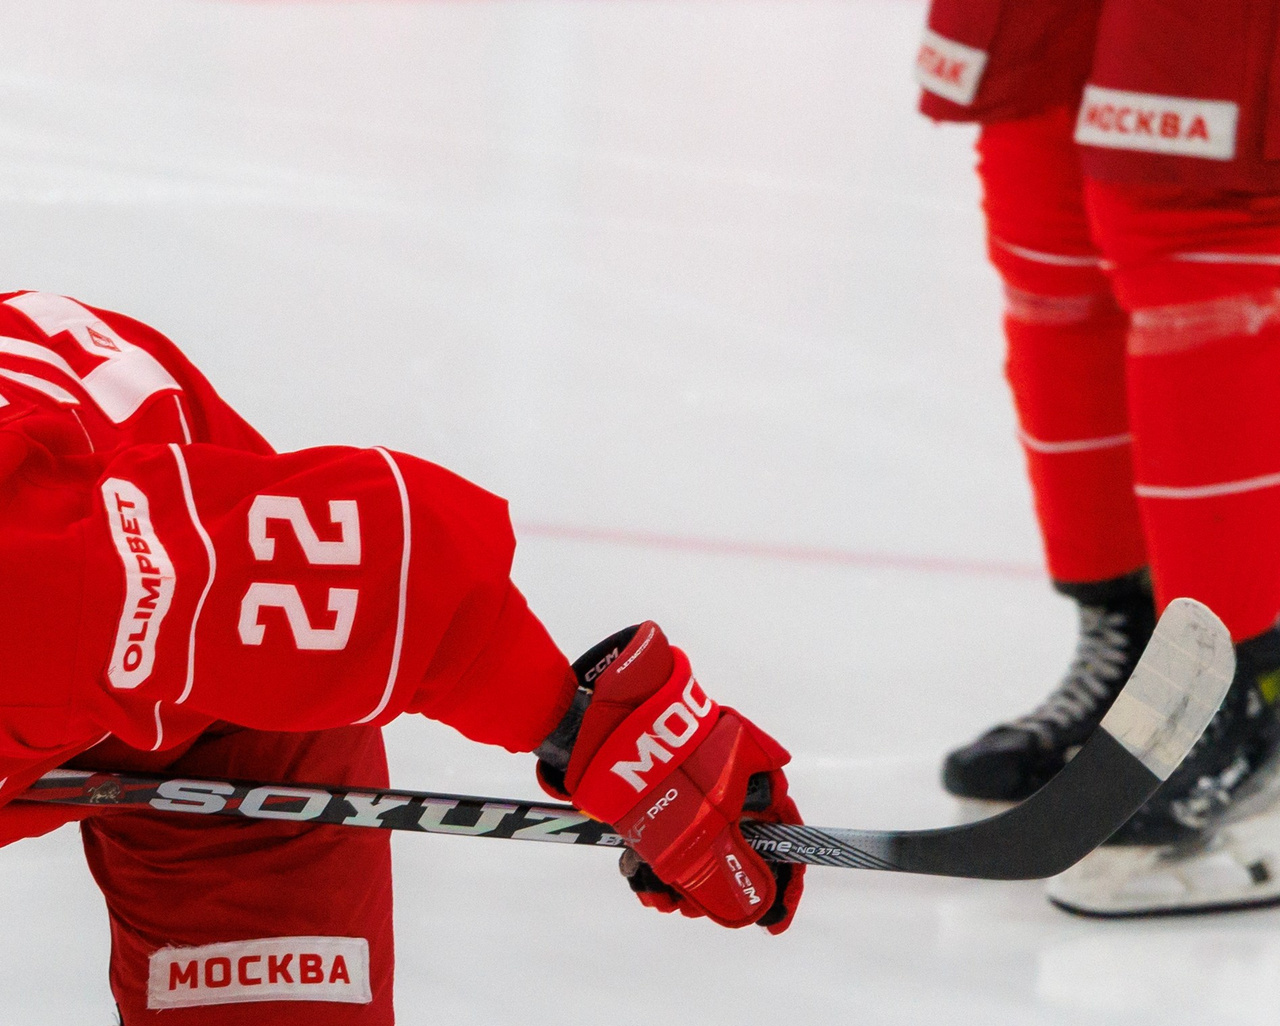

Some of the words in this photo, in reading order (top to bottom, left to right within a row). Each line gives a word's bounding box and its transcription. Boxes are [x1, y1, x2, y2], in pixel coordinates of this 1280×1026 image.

[114, 491, 162, 672] OLIMPBET
[237, 494, 362, 651] 22
[584, 647, 619, 682] CCM
[148, 779, 593, 843] SOYUZ
[646, 788, 678, 820] PRO
[725, 854, 761, 905] CCM
[168, 953, 351, 991] МОСКВА
